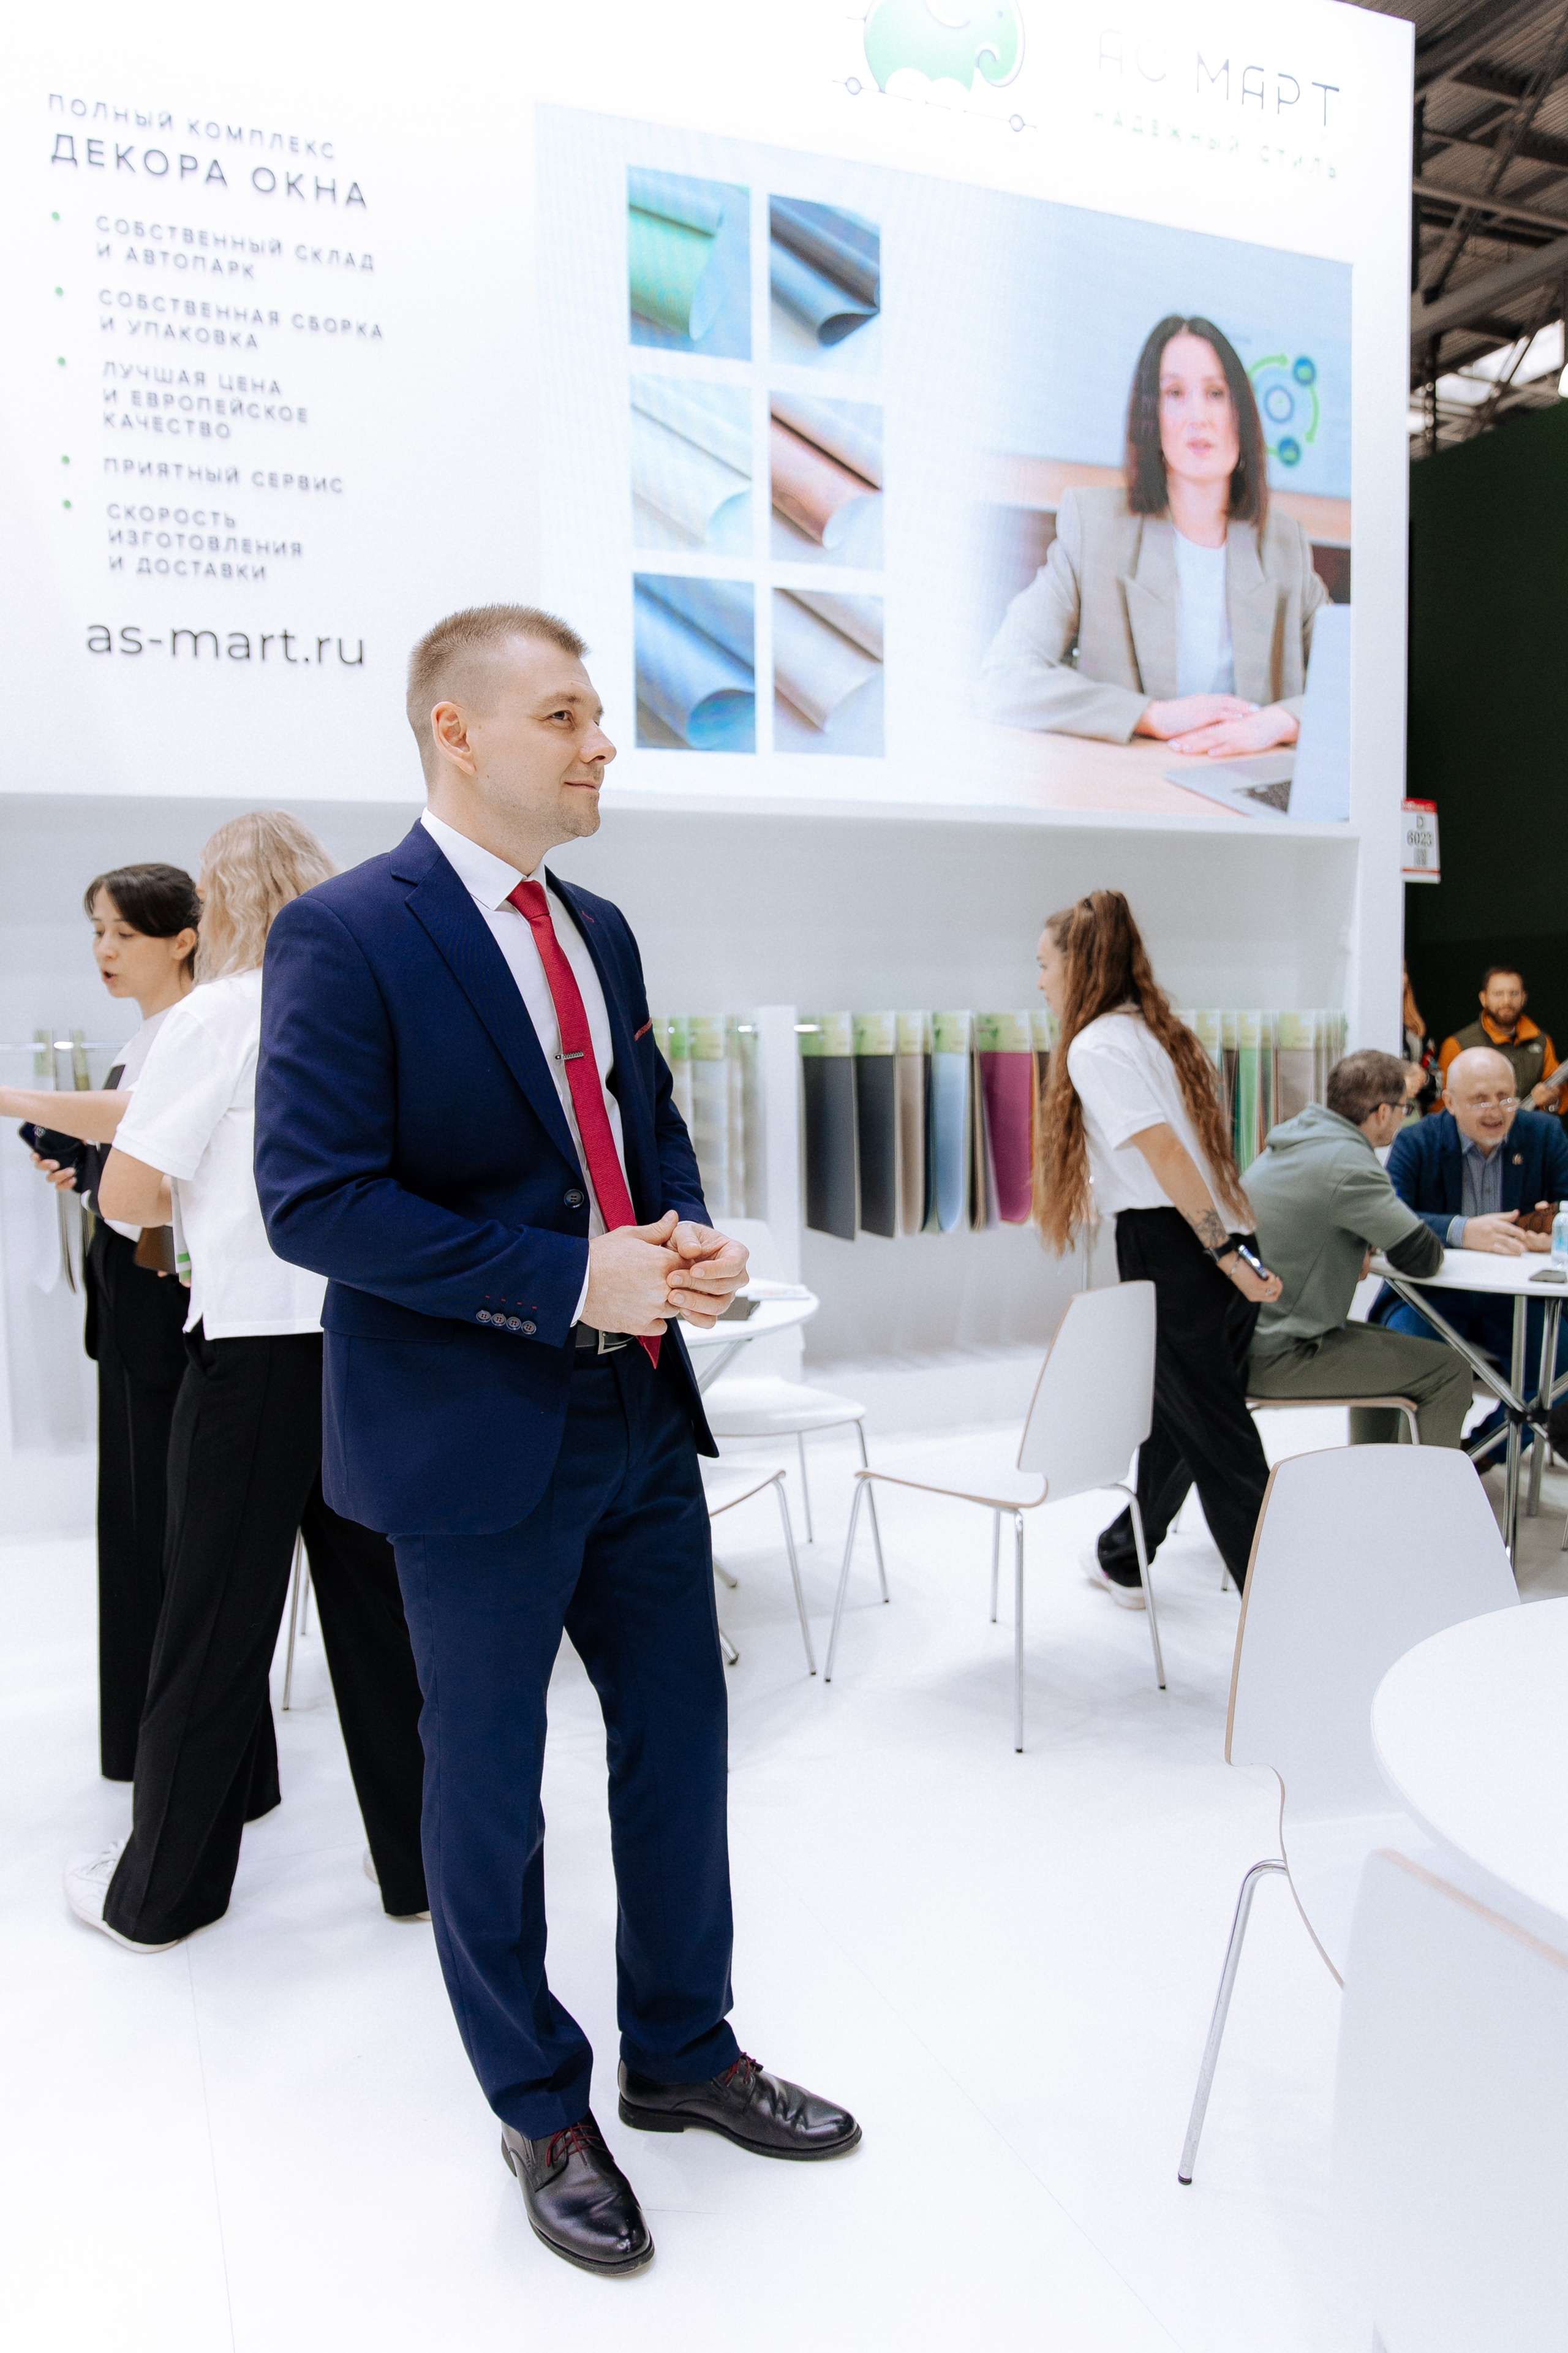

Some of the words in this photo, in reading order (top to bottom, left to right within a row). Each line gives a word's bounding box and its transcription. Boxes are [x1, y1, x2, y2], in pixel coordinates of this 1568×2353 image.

[1196, 50, 1340, 127] МАРТ
[48, 93, 173, 130] ПОЛНЫЙ
[188, 118, 335, 159] КОМПЛЕКС
[51, 133, 228, 187] ДЕКОРА
[252, 167, 367, 208] ОКНА
[96, 215, 282, 255] СОБСТВЕННЫЙ
[295, 244, 375, 271] СКЛАД
[96, 242, 111, 259] И
[126, 246, 254, 279] АВТОПАРК
[99, 289, 280, 326] СОБСТВЕННАЯ
[292, 313, 383, 340] СБОРКА
[100, 315, 115, 331] И
[127, 319, 258, 349] УПАКОВКА
[103, 361, 206, 387] ЛУЧШАЯ
[219, 373, 282, 395] ЦЕНА
[103, 388, 117, 404] И
[130, 390, 308, 423] ЕВРОПЕЙСКОЕ
[103, 412, 231, 439] КАЧЕСТВО
[104, 457, 238, 485] ПРИЯТНЫЙ
[251, 470, 344, 494] СЕРВИС
[107, 502, 236, 529] СКОРОСТЬ
[108, 529, 303, 557] ИЗГОТОВЛЕНИЯ
[108, 554, 123, 571] И
[136, 557, 266, 581] ДОСТАВКИ
[86, 623, 364, 665] as-mart.ru
